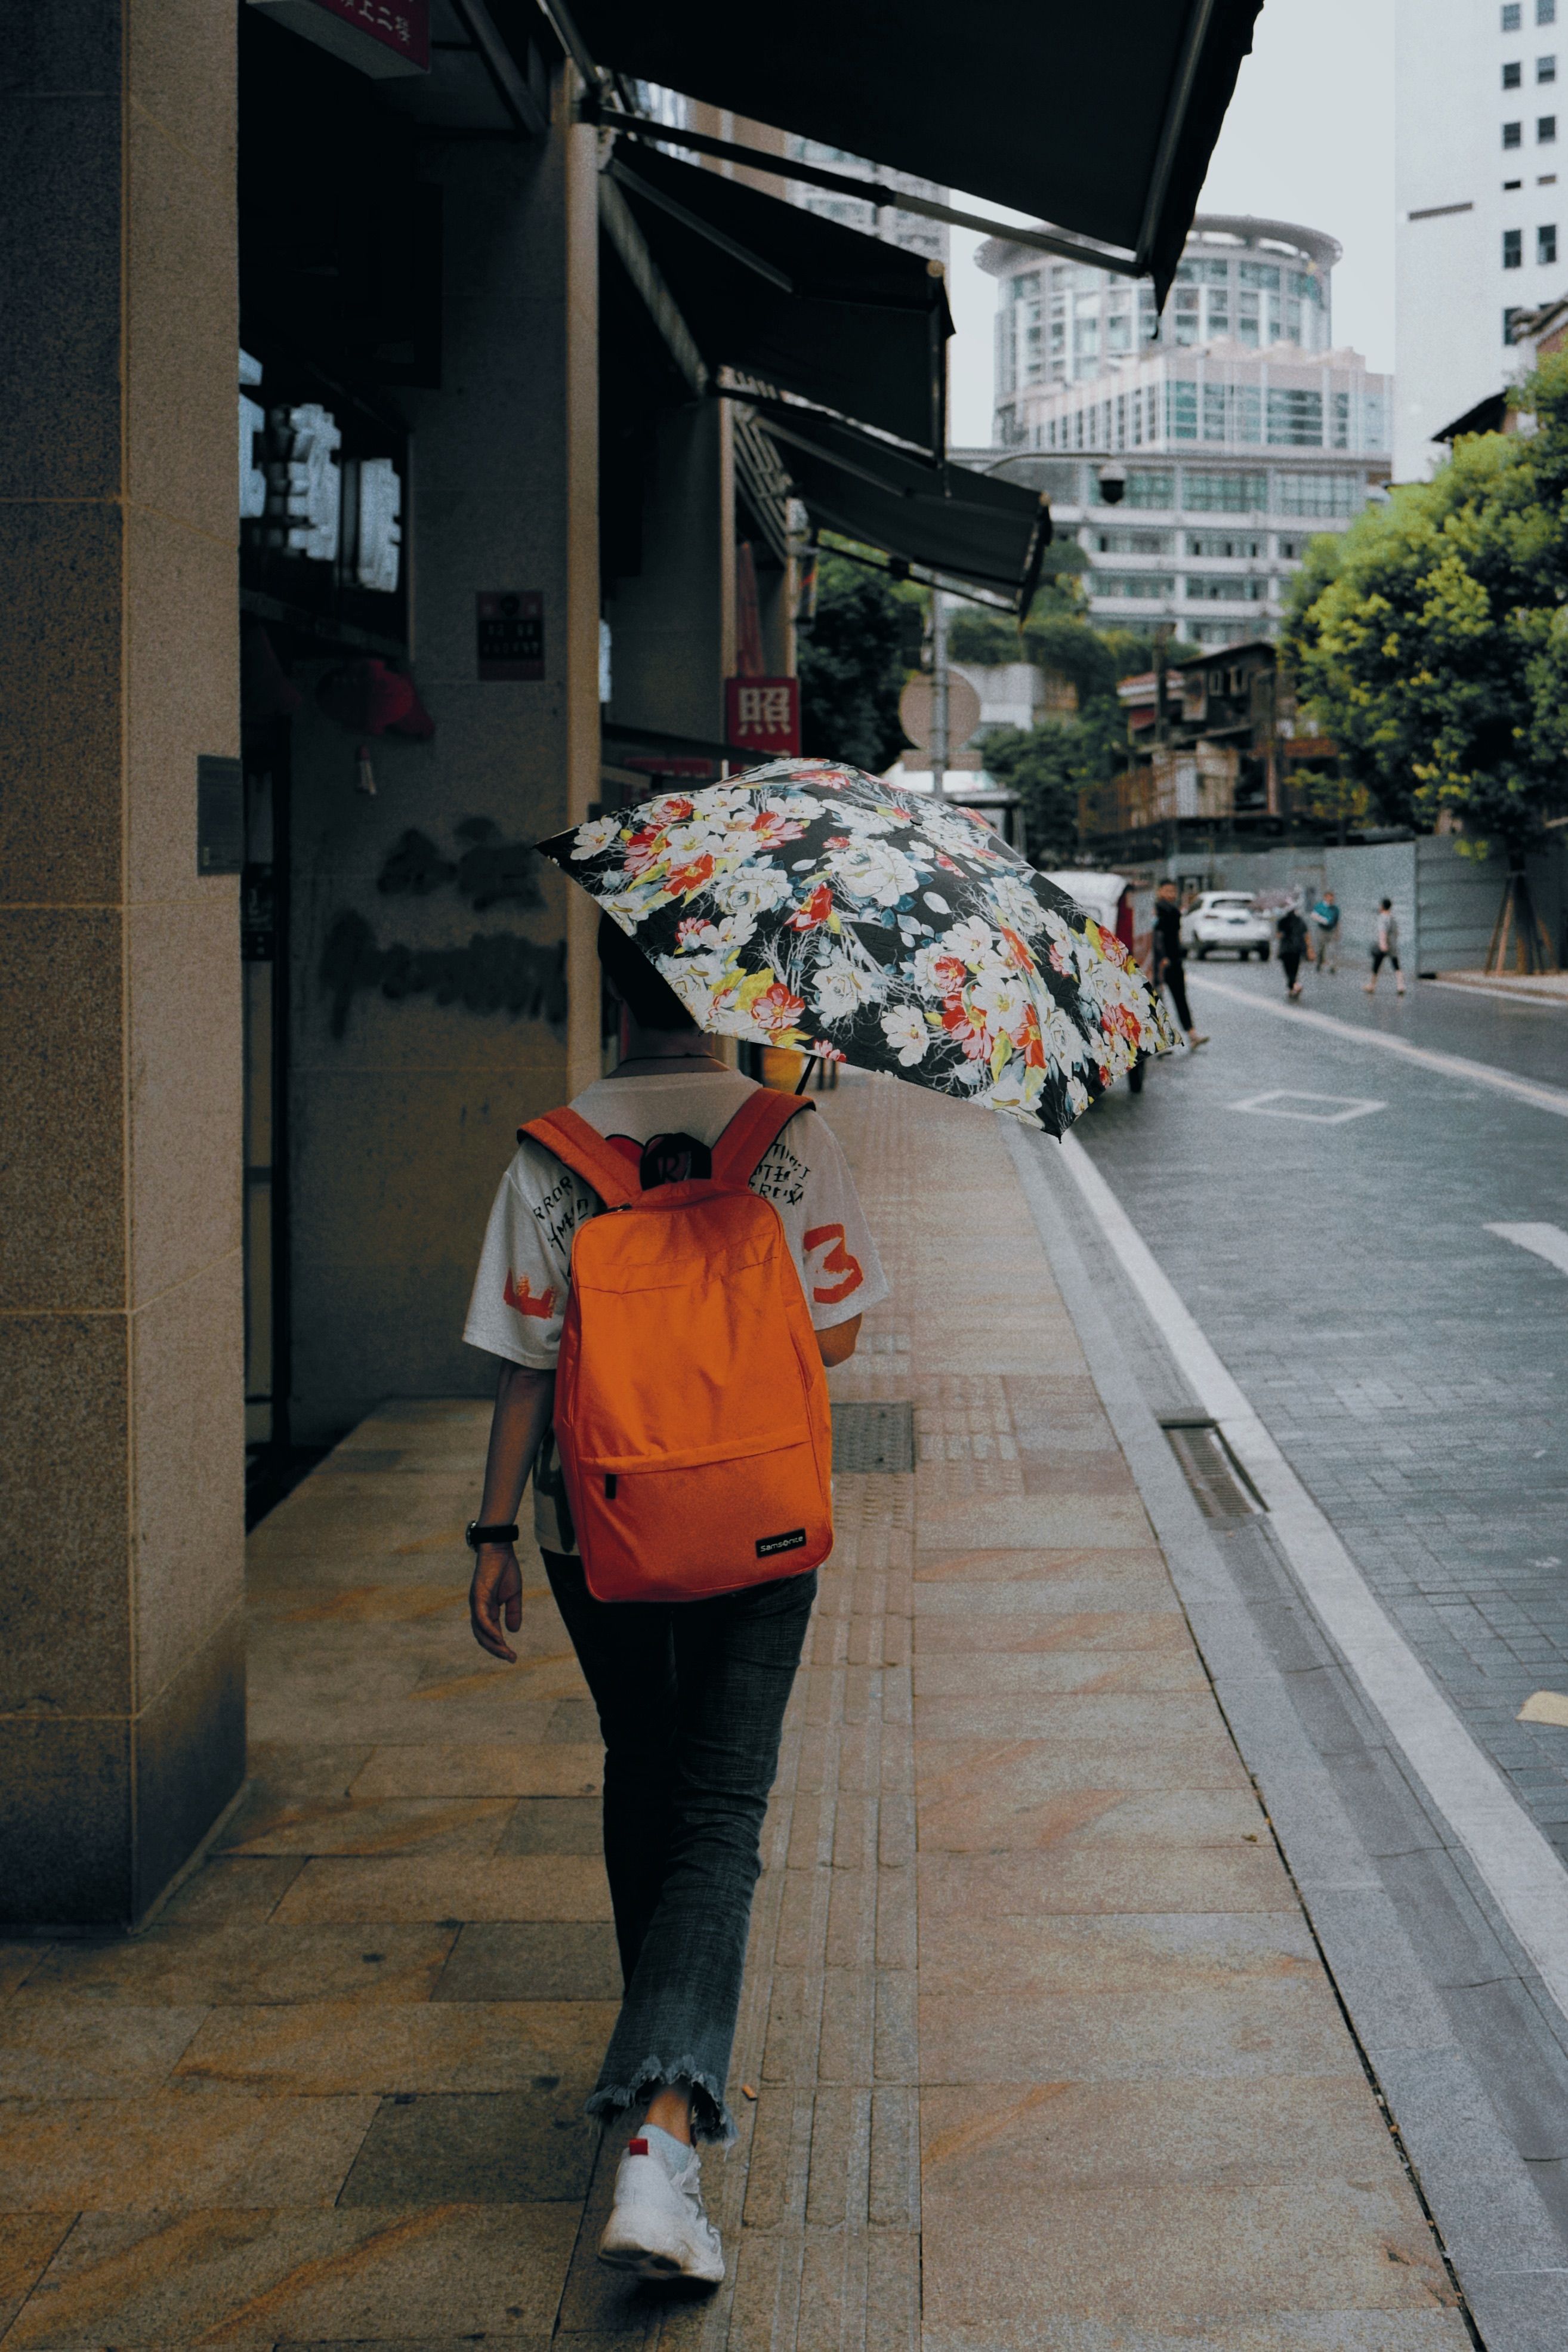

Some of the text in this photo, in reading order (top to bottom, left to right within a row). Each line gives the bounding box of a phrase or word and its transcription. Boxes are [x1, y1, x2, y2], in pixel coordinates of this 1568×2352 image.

[737, 687, 792, 757] 照
[804, 1224, 863, 1304] 3
[760, 1536, 804, 1552] Samsonite
